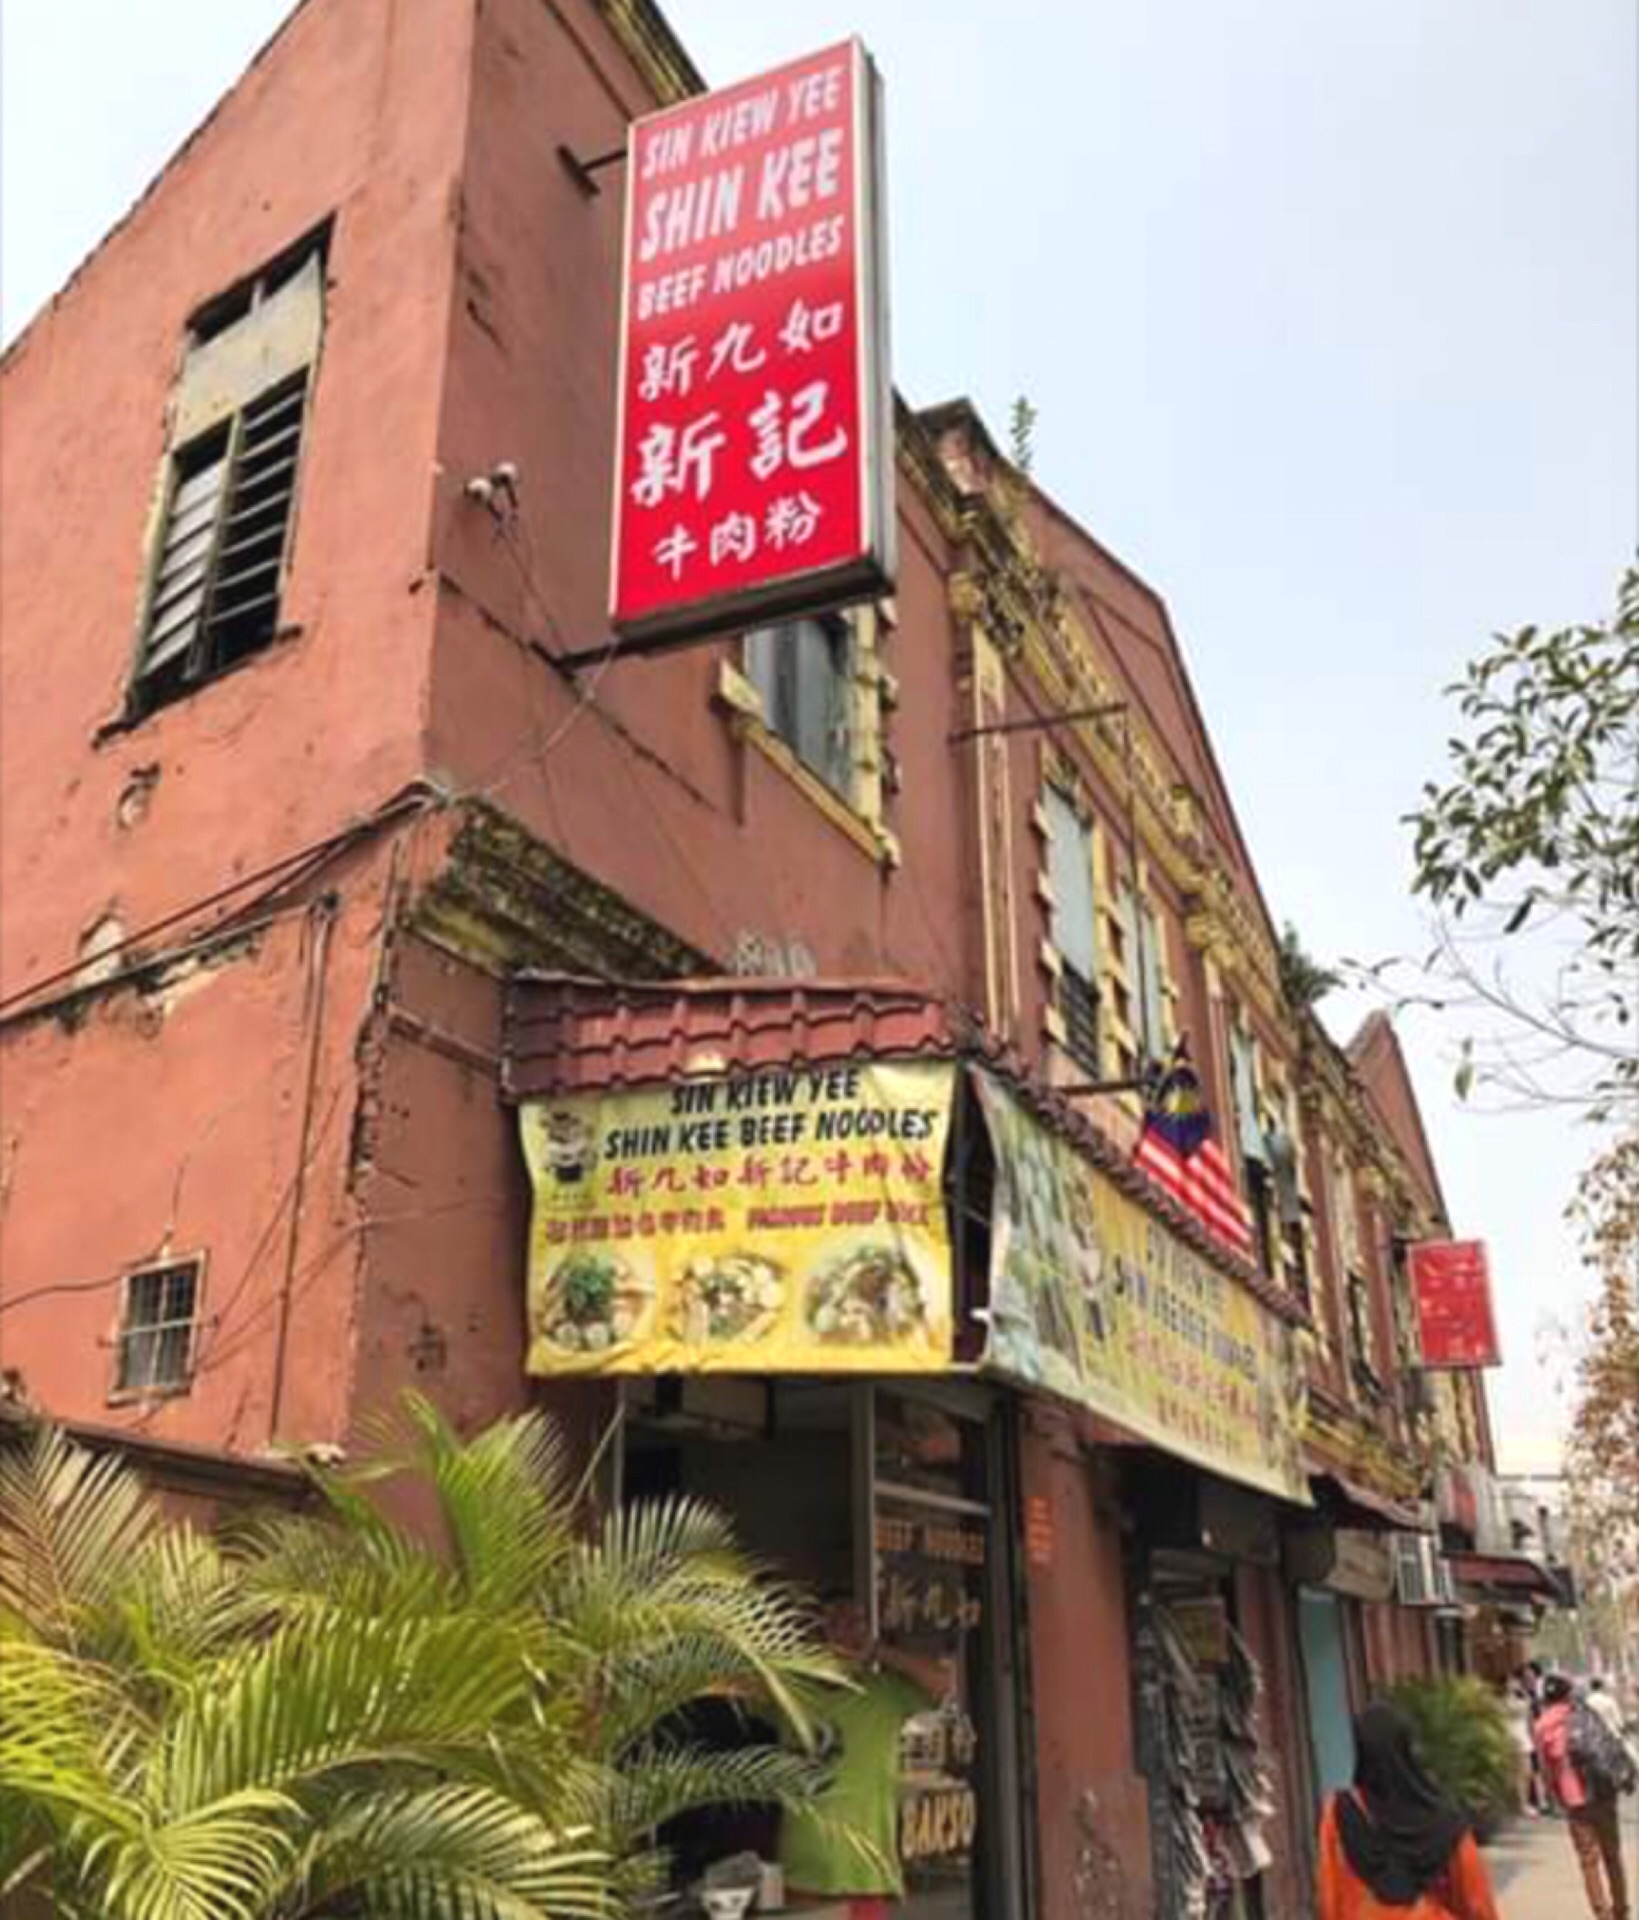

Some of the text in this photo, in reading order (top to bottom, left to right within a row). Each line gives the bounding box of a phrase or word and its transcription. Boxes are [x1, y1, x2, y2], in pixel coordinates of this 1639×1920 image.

[641, 66, 843, 180] SIN KIEW YEE
[640, 128, 844, 262] SHIN KEE
[637, 215, 844, 321] BEEF NOODLES
[638, 298, 843, 402] 新九如
[630, 380, 848, 508] 新記
[654, 490, 822, 582] 牛肉粉
[604, 1107, 939, 1160] SHIN KEE BEEF NOODLES
[671, 1084, 715, 1115] SIN
[809, 1067, 860, 1103] YEE
